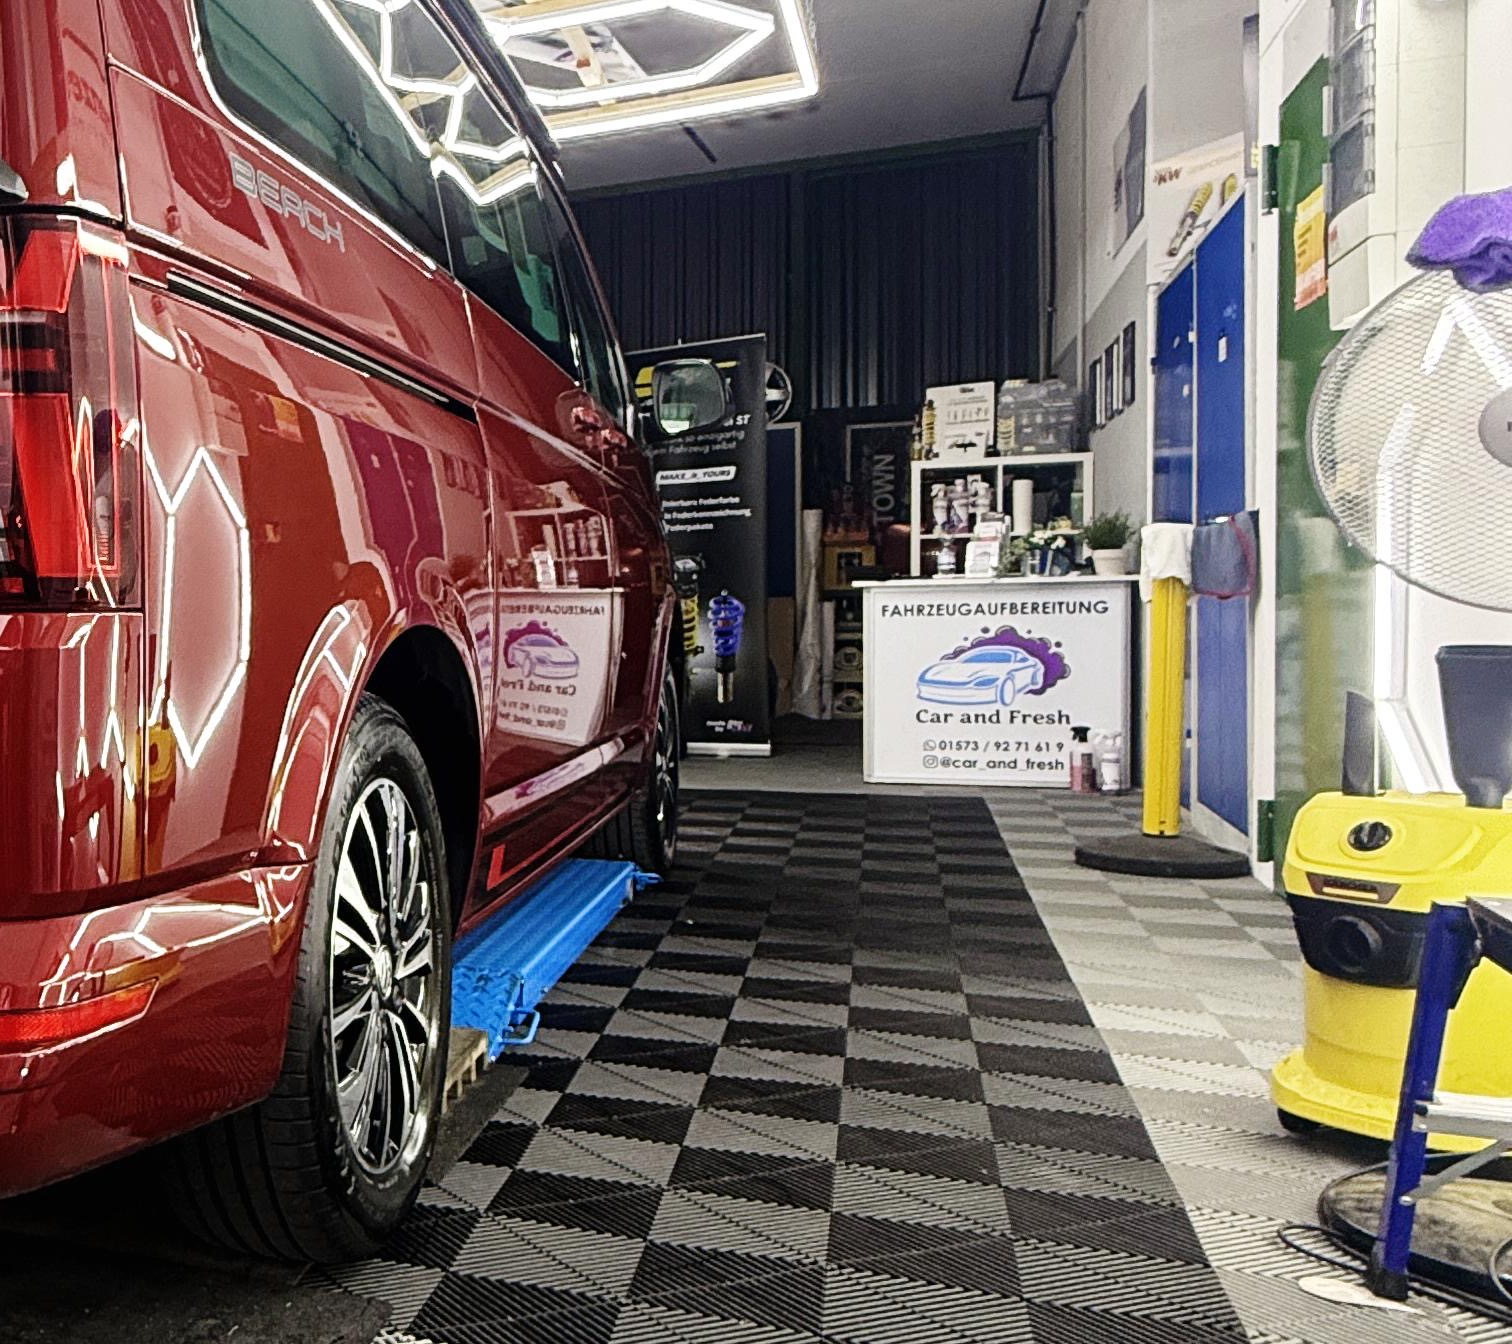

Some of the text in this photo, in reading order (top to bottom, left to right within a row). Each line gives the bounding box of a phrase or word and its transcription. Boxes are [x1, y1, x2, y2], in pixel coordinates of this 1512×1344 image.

[228, 151, 345, 253] BEACH
[872, 453, 896, 526] TOWN
[881, 600, 1109, 617] FAHRZEUGAUFBEREITUNG
[916, 709, 1071, 725] Car and Fresh
[939, 740, 979, 752] 01573
[994, 741, 1010, 752] 92
[1015, 741, 1029, 752] 71
[1034, 741, 1050, 752] 61
[1056, 742, 1064, 752] 9
[939, 757, 1065, 772] @car_and_fresh
